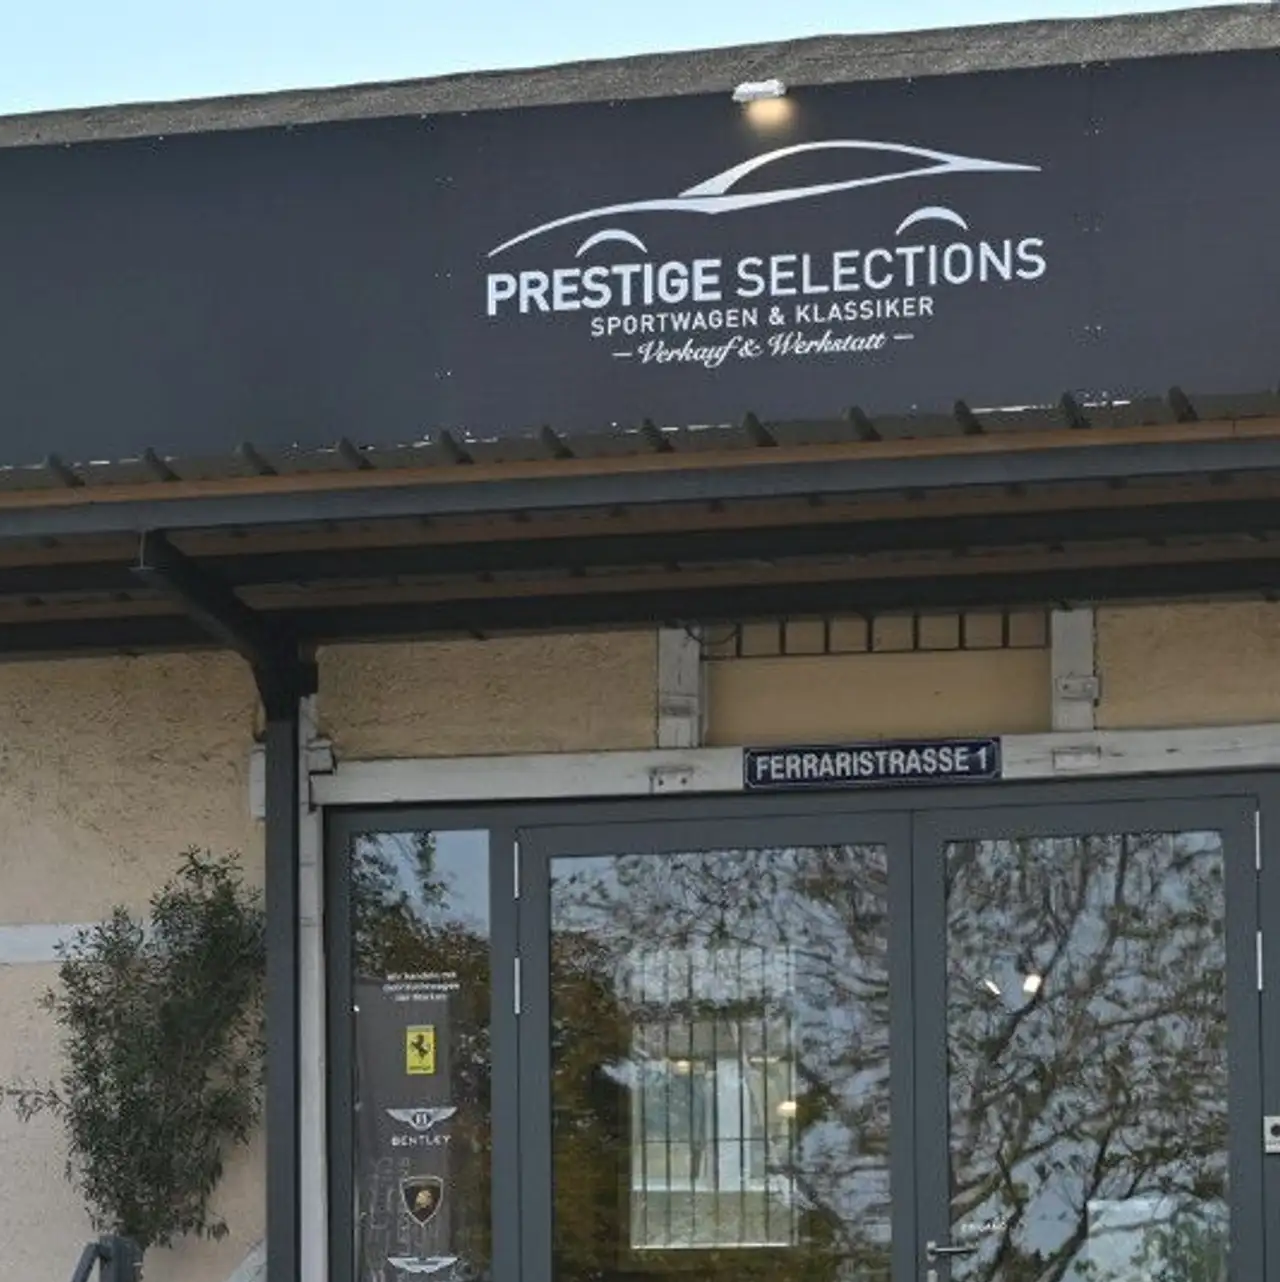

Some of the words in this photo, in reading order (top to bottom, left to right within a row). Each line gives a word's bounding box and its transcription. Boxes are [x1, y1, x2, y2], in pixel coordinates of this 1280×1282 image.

[487, 258, 722, 316] PRESTIGE
[736, 237, 1046, 298] SELECTIONS
[591, 307, 758, 336] SPORTWAGEN
[768, 306, 785, 325] &
[795, 296, 934, 323] KLASSIKER
[637, 335, 743, 368] Verkauf
[737, 338, 764, 357] &
[767, 329, 889, 357] Werkstatt
[755, 747, 970, 780] FERRARISTRASSE
[977, 747, 989, 770] 1
[391, 1134, 452, 1147] BENTLEY
